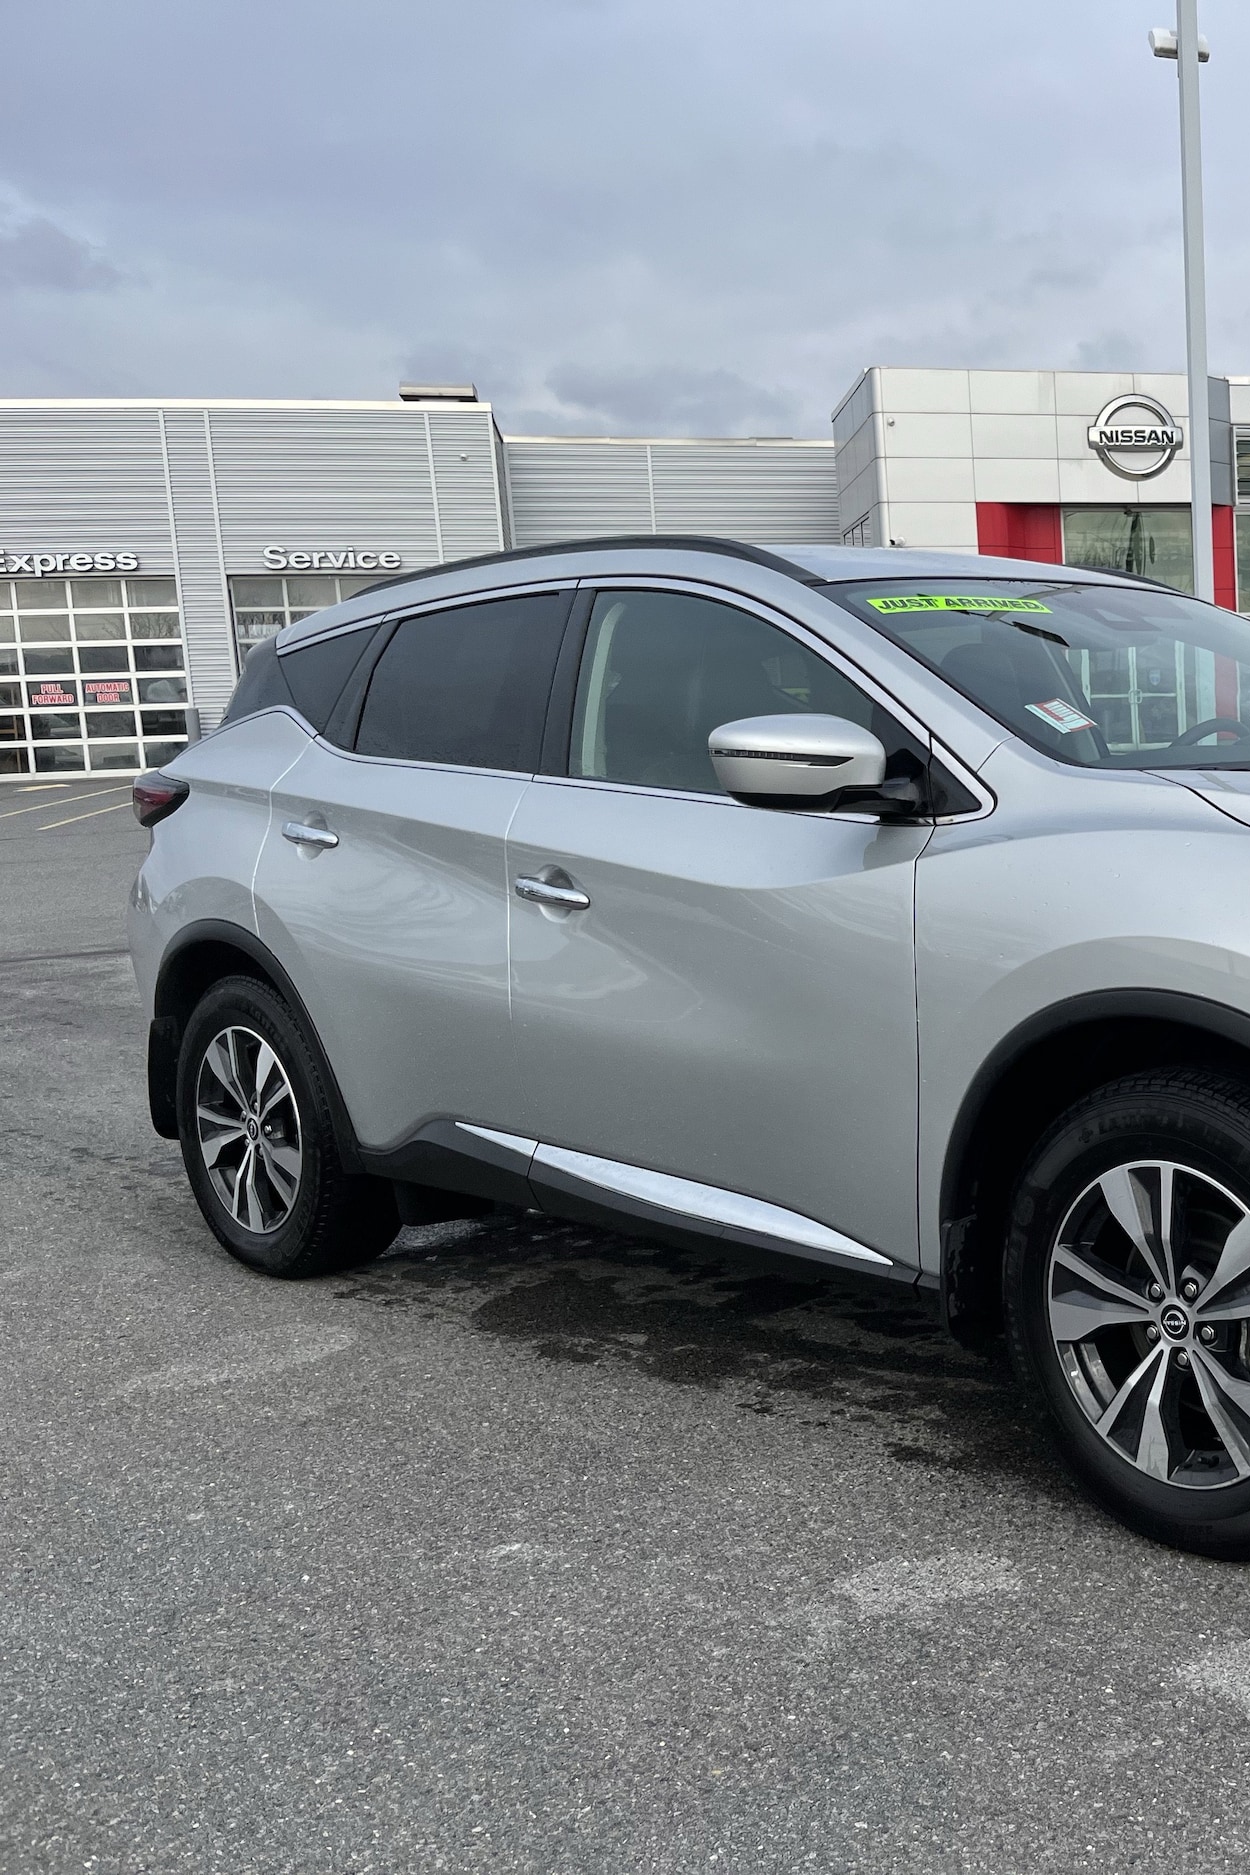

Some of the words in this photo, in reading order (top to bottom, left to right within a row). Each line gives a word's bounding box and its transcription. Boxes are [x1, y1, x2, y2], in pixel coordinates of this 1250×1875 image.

[1099, 430, 1175, 445] NISSAN
[263, 546, 401, 570] Service
[879, 599, 938, 610] JUST
[945, 598, 1041, 610] ARRIVED
[40, 684, 64, 694] PULL
[85, 682, 130, 693] AUTOMATIC
[31, 694, 75, 705] FORWARD
[96, 693, 120, 703] DOOR
